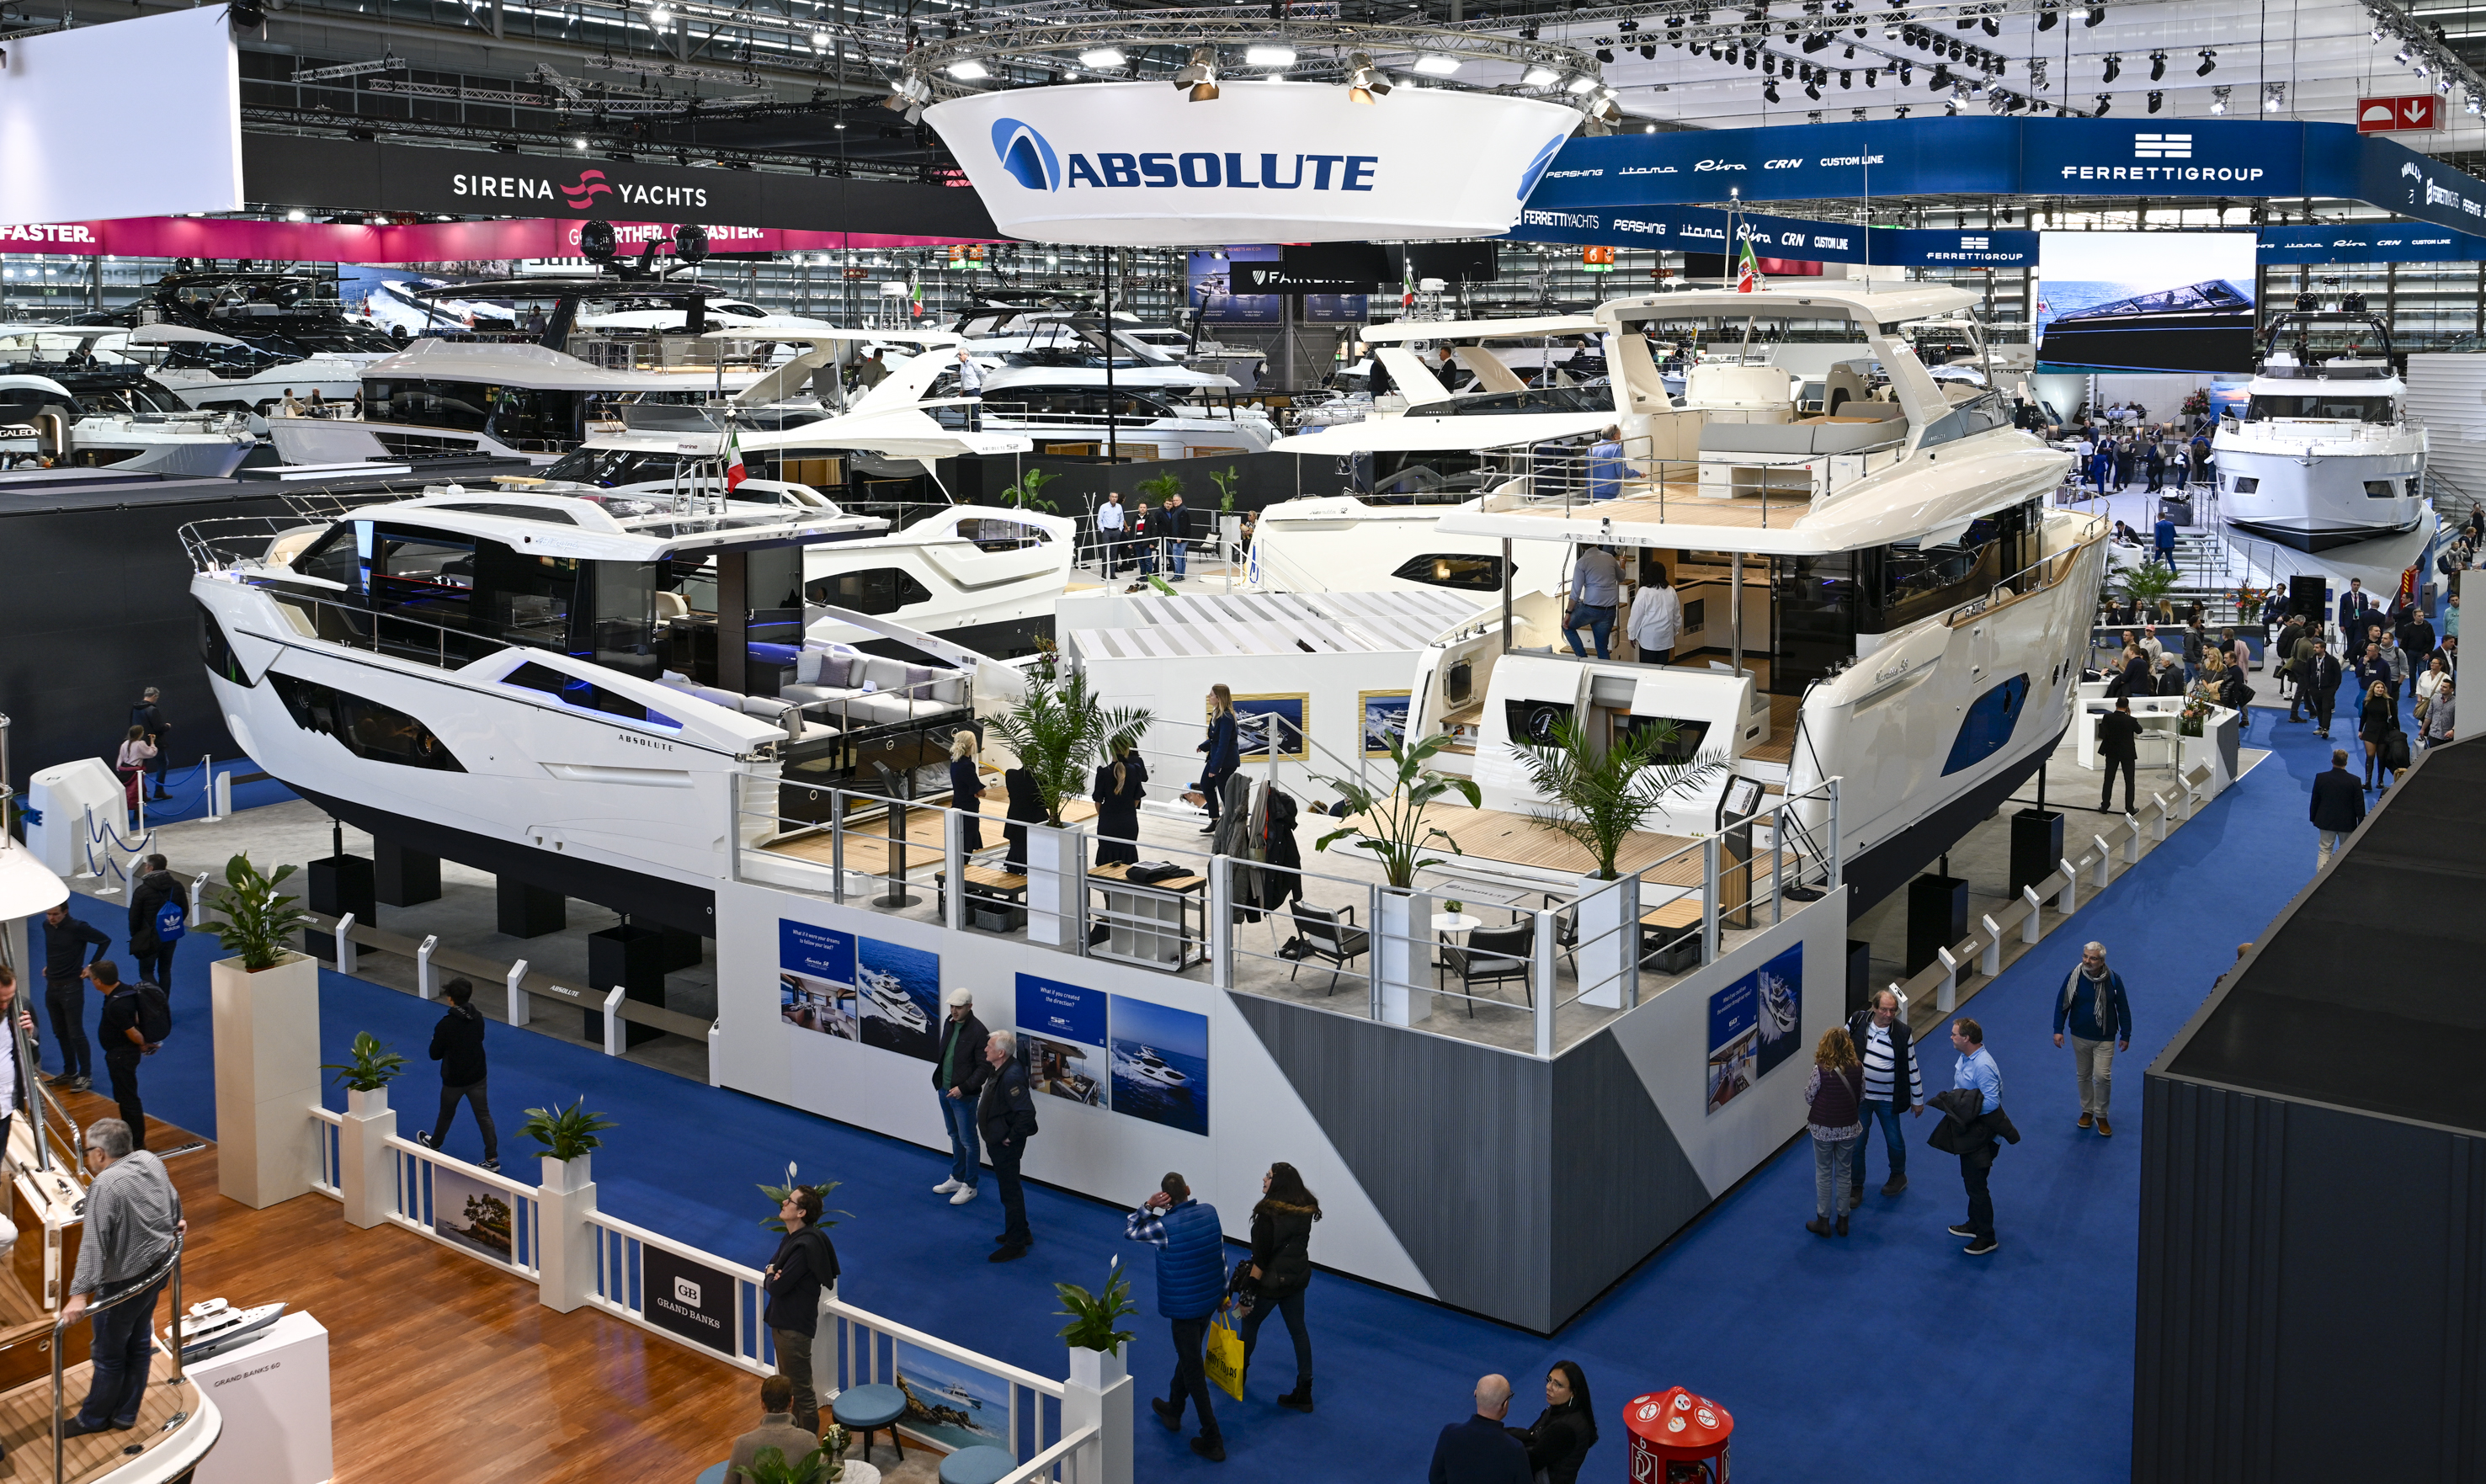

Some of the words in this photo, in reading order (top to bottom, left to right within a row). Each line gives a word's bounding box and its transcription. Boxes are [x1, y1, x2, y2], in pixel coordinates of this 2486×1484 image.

[1067, 152, 1379, 192] ABSOLUTE
[1546, 168, 1604, 178] PERSHING
[1618, 167, 1678, 175] itama
[1694, 158, 1748, 173] Riva
[1764, 158, 1803, 169] CRN
[1820, 157, 1860, 167] CUSTOM
[1861, 155, 1884, 165] LINE
[2061, 166, 2264, 182] FERRETTIGROUP
[2401, 162, 2422, 184] WALLY
[453, 173, 555, 200] SIRENA
[618, 183, 707, 207] YACHTS
[2462, 198, 2481, 217] PERSHING
[0, 223, 96, 243] FASTER.
[615, 225, 667, 245] RTHER,
[1613, 219, 1666, 235] PERSHING
[1680, 224, 1725, 240] itama
[1736, 223, 1771, 244] Riva
[1781, 231, 1805, 247] CRN
[1814, 236, 1835, 249] CUSTOM
[1836, 237, 1849, 250] LINE
[2333, 239, 2367, 247] Riva
[0, 428, 42, 438] GALEON
[1564, 533, 1648, 545] ABSOLUTE
[618, 734, 673, 753] ABSOLUTE
[1456, 886, 1509, 899] ABSOLUTE
[1962, 940, 1978, 955] ABSOLUTE
[805, 957, 822, 965] Navetta
[550, 985, 580, 997] ABSOLUTE
[1063, 992, 1080, 1002] created
[1053, 997, 1075, 1008] direction?
[1050, 1015, 1065, 1025] 52
[1728, 1017, 1738, 1027] 60
[678, 1285, 697, 1300] GB
[657, 1297, 689, 1316] GRAND
[689, 1309, 721, 1329] BANKS
[214, 1374, 242, 1388] GRAND
[242, 1364, 269, 1379] BANKS
[269, 1361, 281, 1370] 60
[1221, 1360, 1237, 1378] TOURS
[1639, 1436, 1647, 1450] 6
